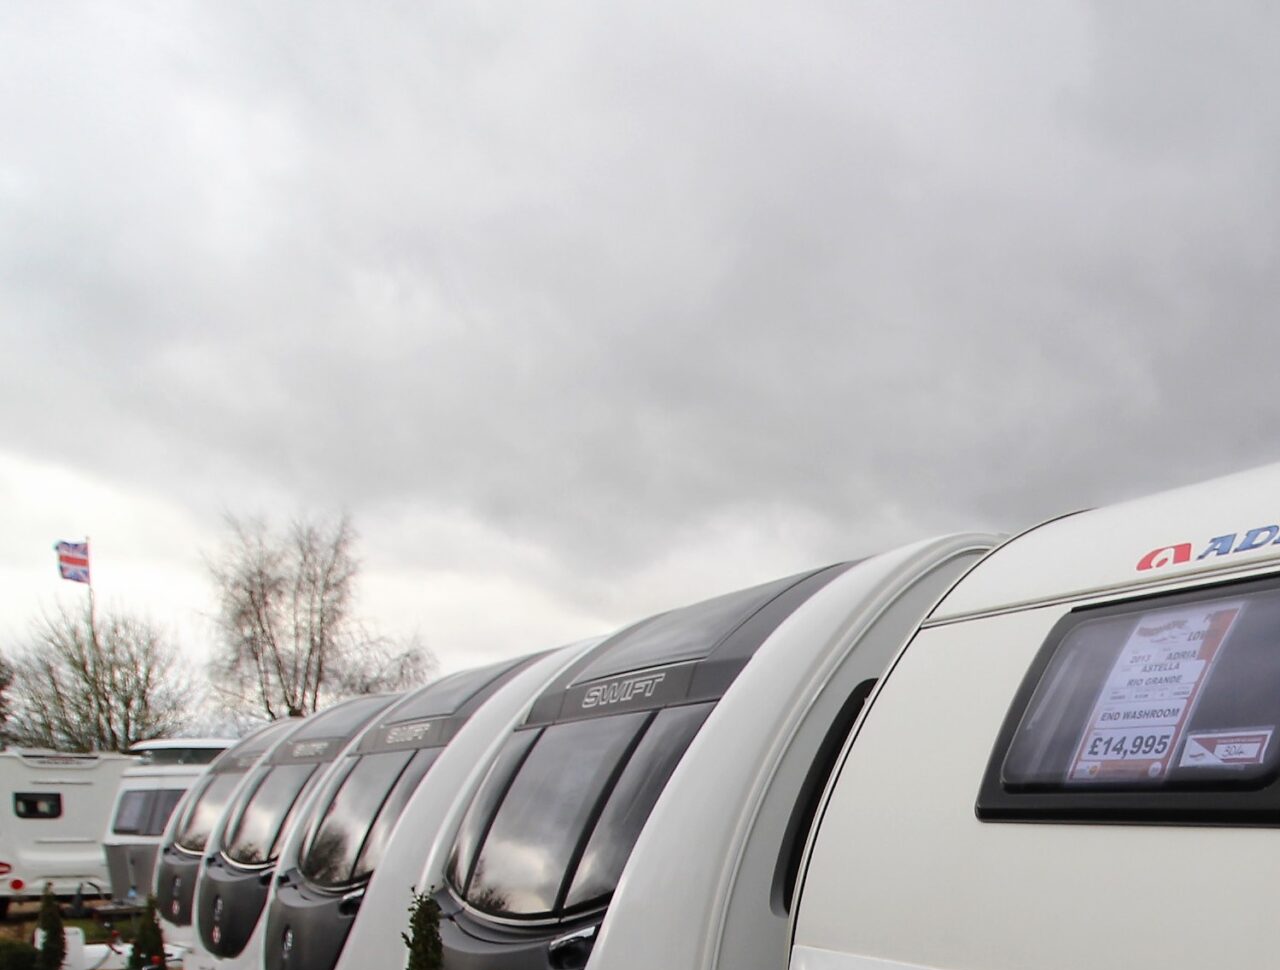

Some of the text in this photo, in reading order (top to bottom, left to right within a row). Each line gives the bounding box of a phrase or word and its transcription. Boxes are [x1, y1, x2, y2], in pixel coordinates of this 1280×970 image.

[1166, 650, 1197, 661] ADRIA
[1140, 662, 1181, 673] ASTELLA
[1126, 675, 1183, 687] RIO GRANDE
[581, 673, 666, 709] SWIFT
[1100, 708, 1181, 722] END WASHROOM
[385, 723, 431, 745] SWIFT
[1088, 735, 1171, 759] £14,995
